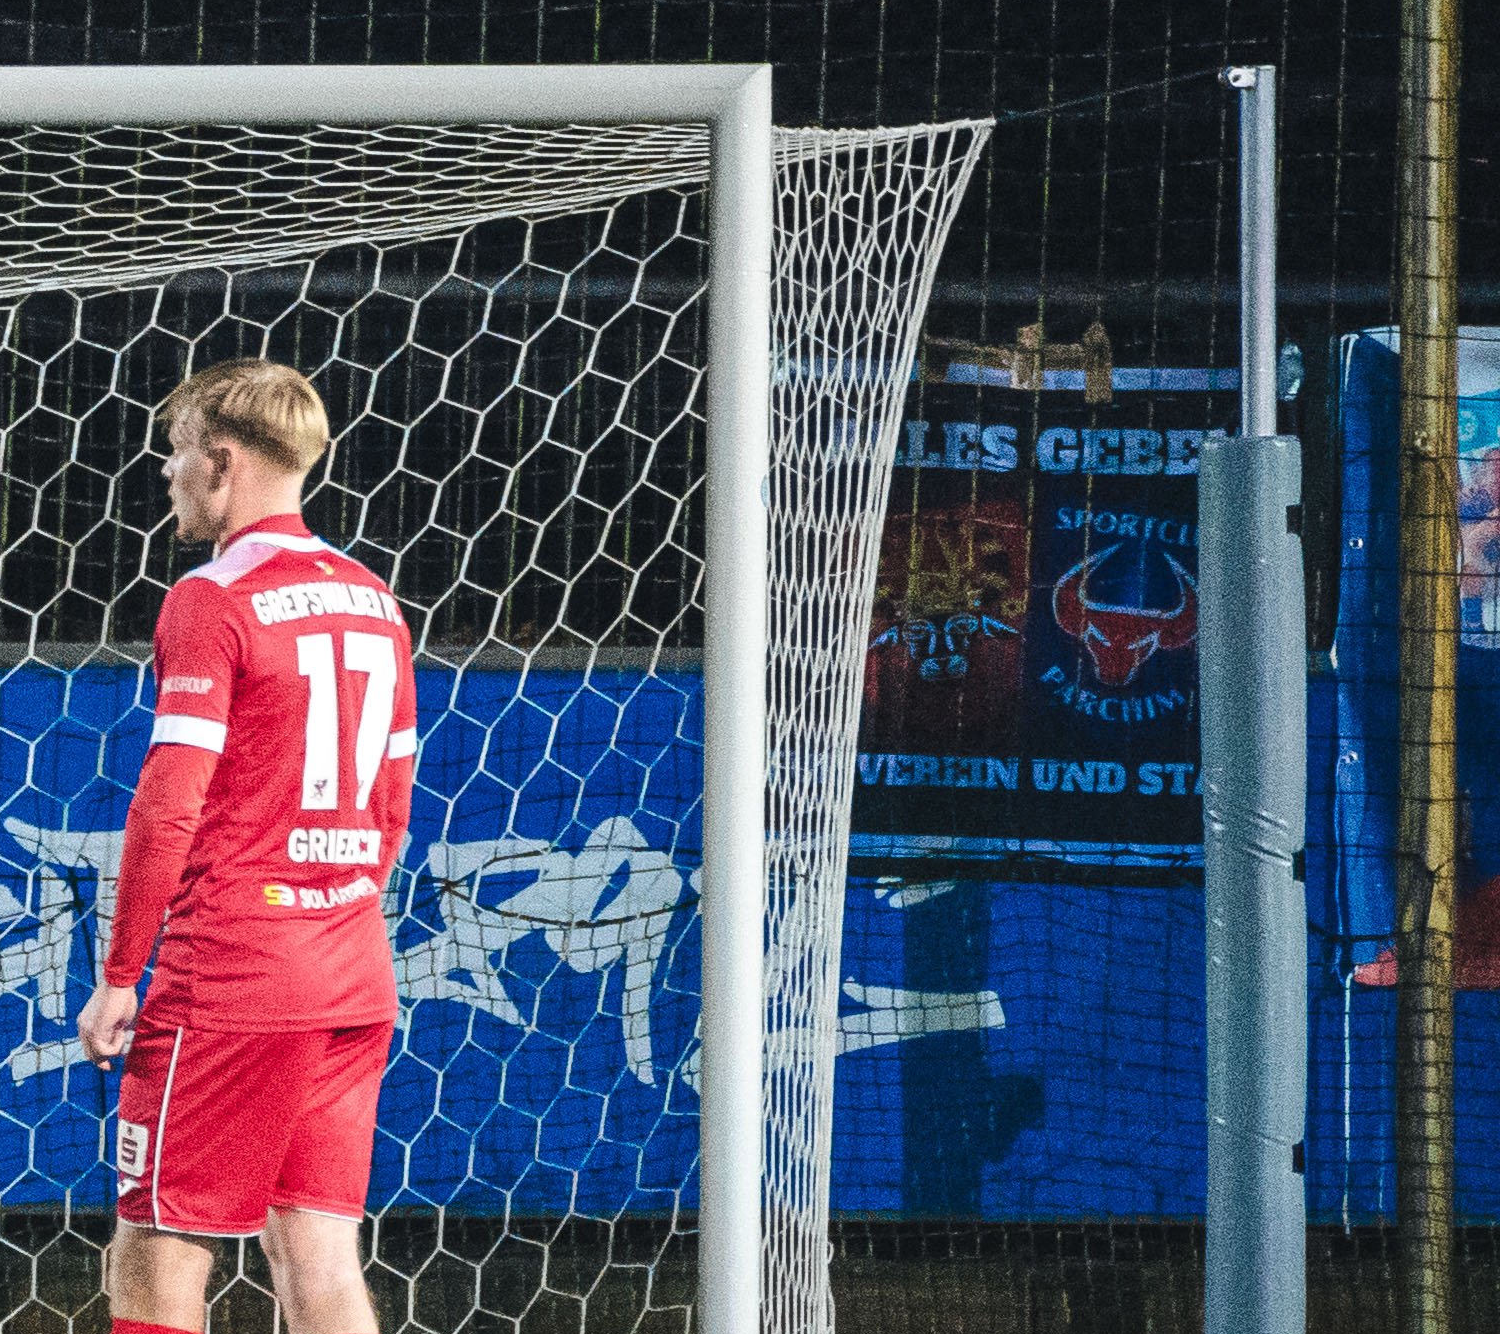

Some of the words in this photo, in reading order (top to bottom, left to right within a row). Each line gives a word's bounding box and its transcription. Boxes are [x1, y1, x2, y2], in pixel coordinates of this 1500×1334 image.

[865, 420, 1019, 472] LES
[1037, 426, 1225, 475] GEBE
[296, 630, 397, 810] 17
[1040, 665, 1185, 722] PARCHIM
[858, 752, 1019, 790] VEREIN
[1032, 758, 1127, 795] UND
